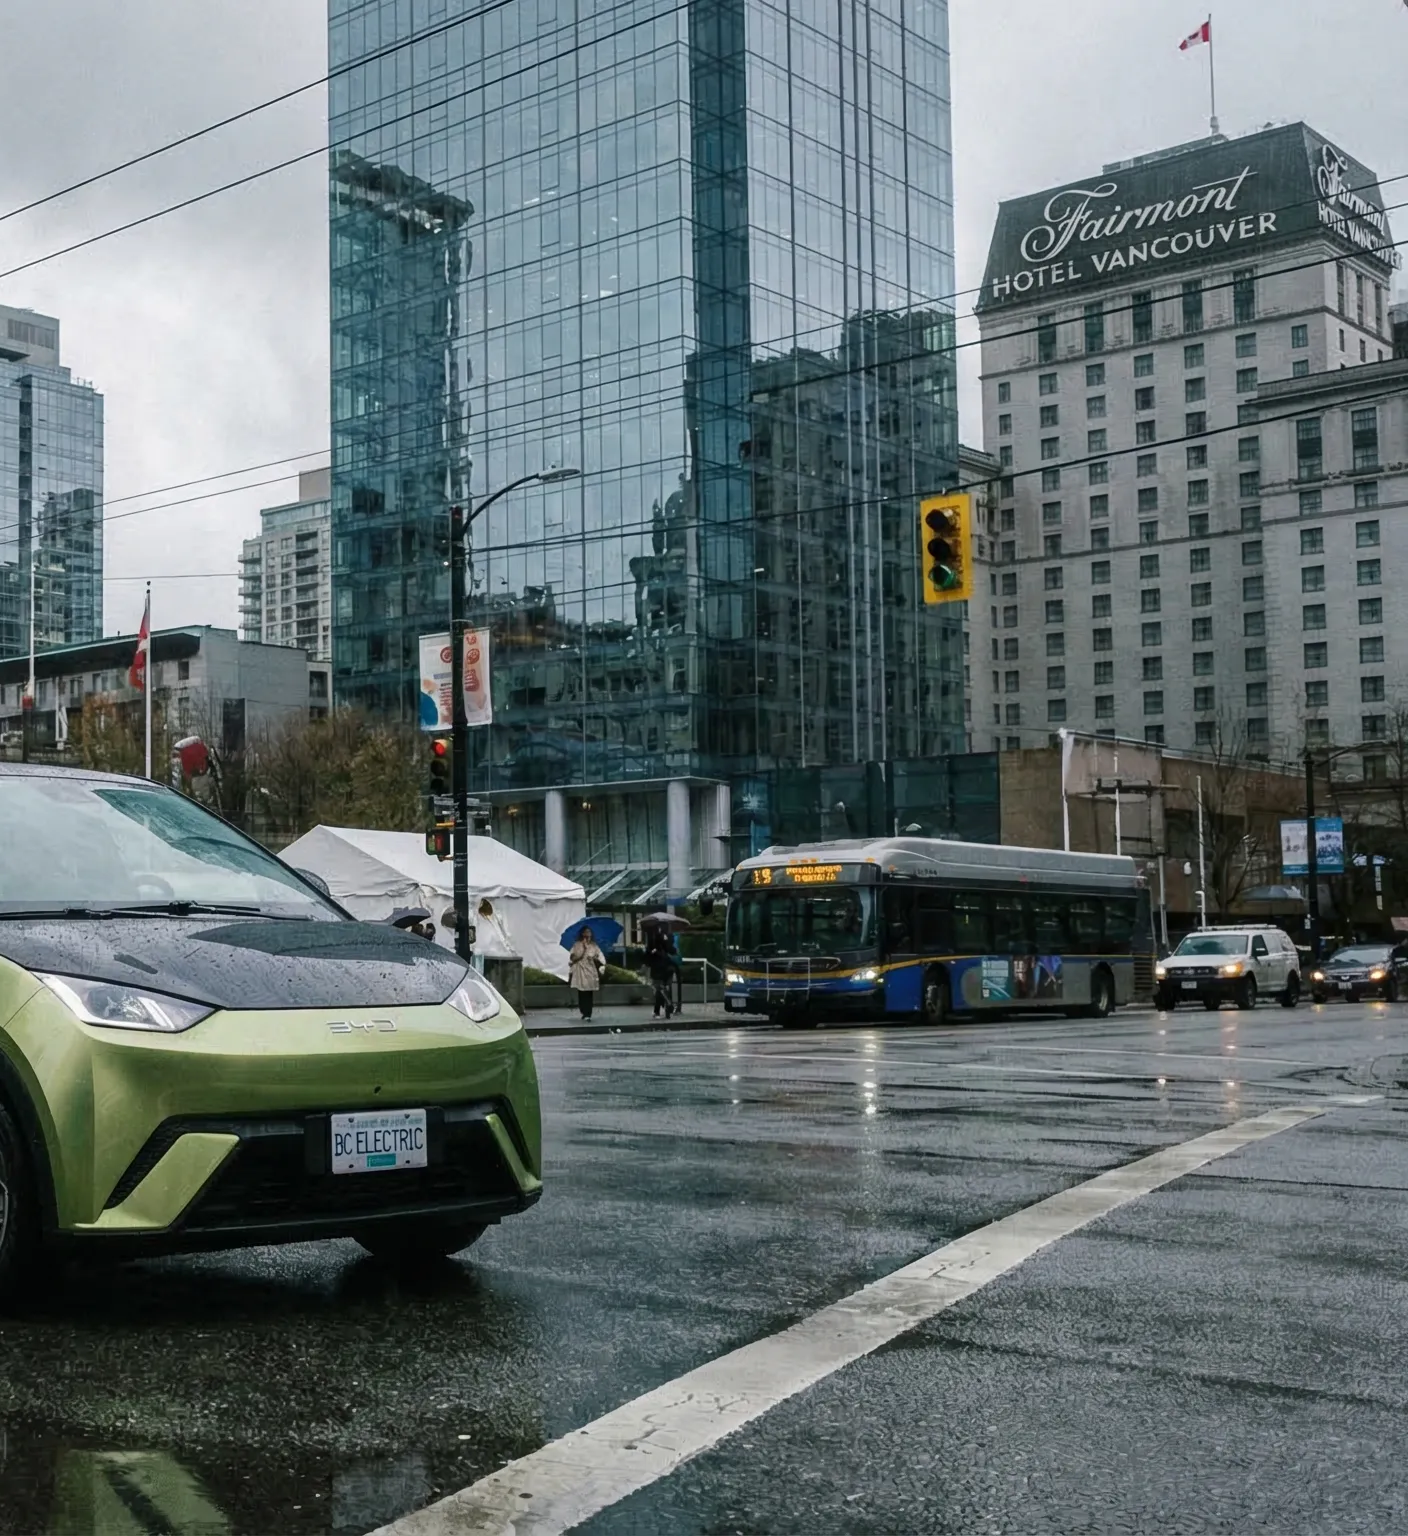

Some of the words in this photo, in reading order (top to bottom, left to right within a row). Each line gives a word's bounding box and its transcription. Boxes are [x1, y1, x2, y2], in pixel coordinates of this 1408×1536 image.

[992, 259, 1081, 298] HOTEL
[1091, 212, 1277, 273] VANCOUVER
[1020, 165, 1259, 263] Fairmont
[334, 1133, 353, 1156] BC
[356, 1127, 424, 1154] ELECTRIC
